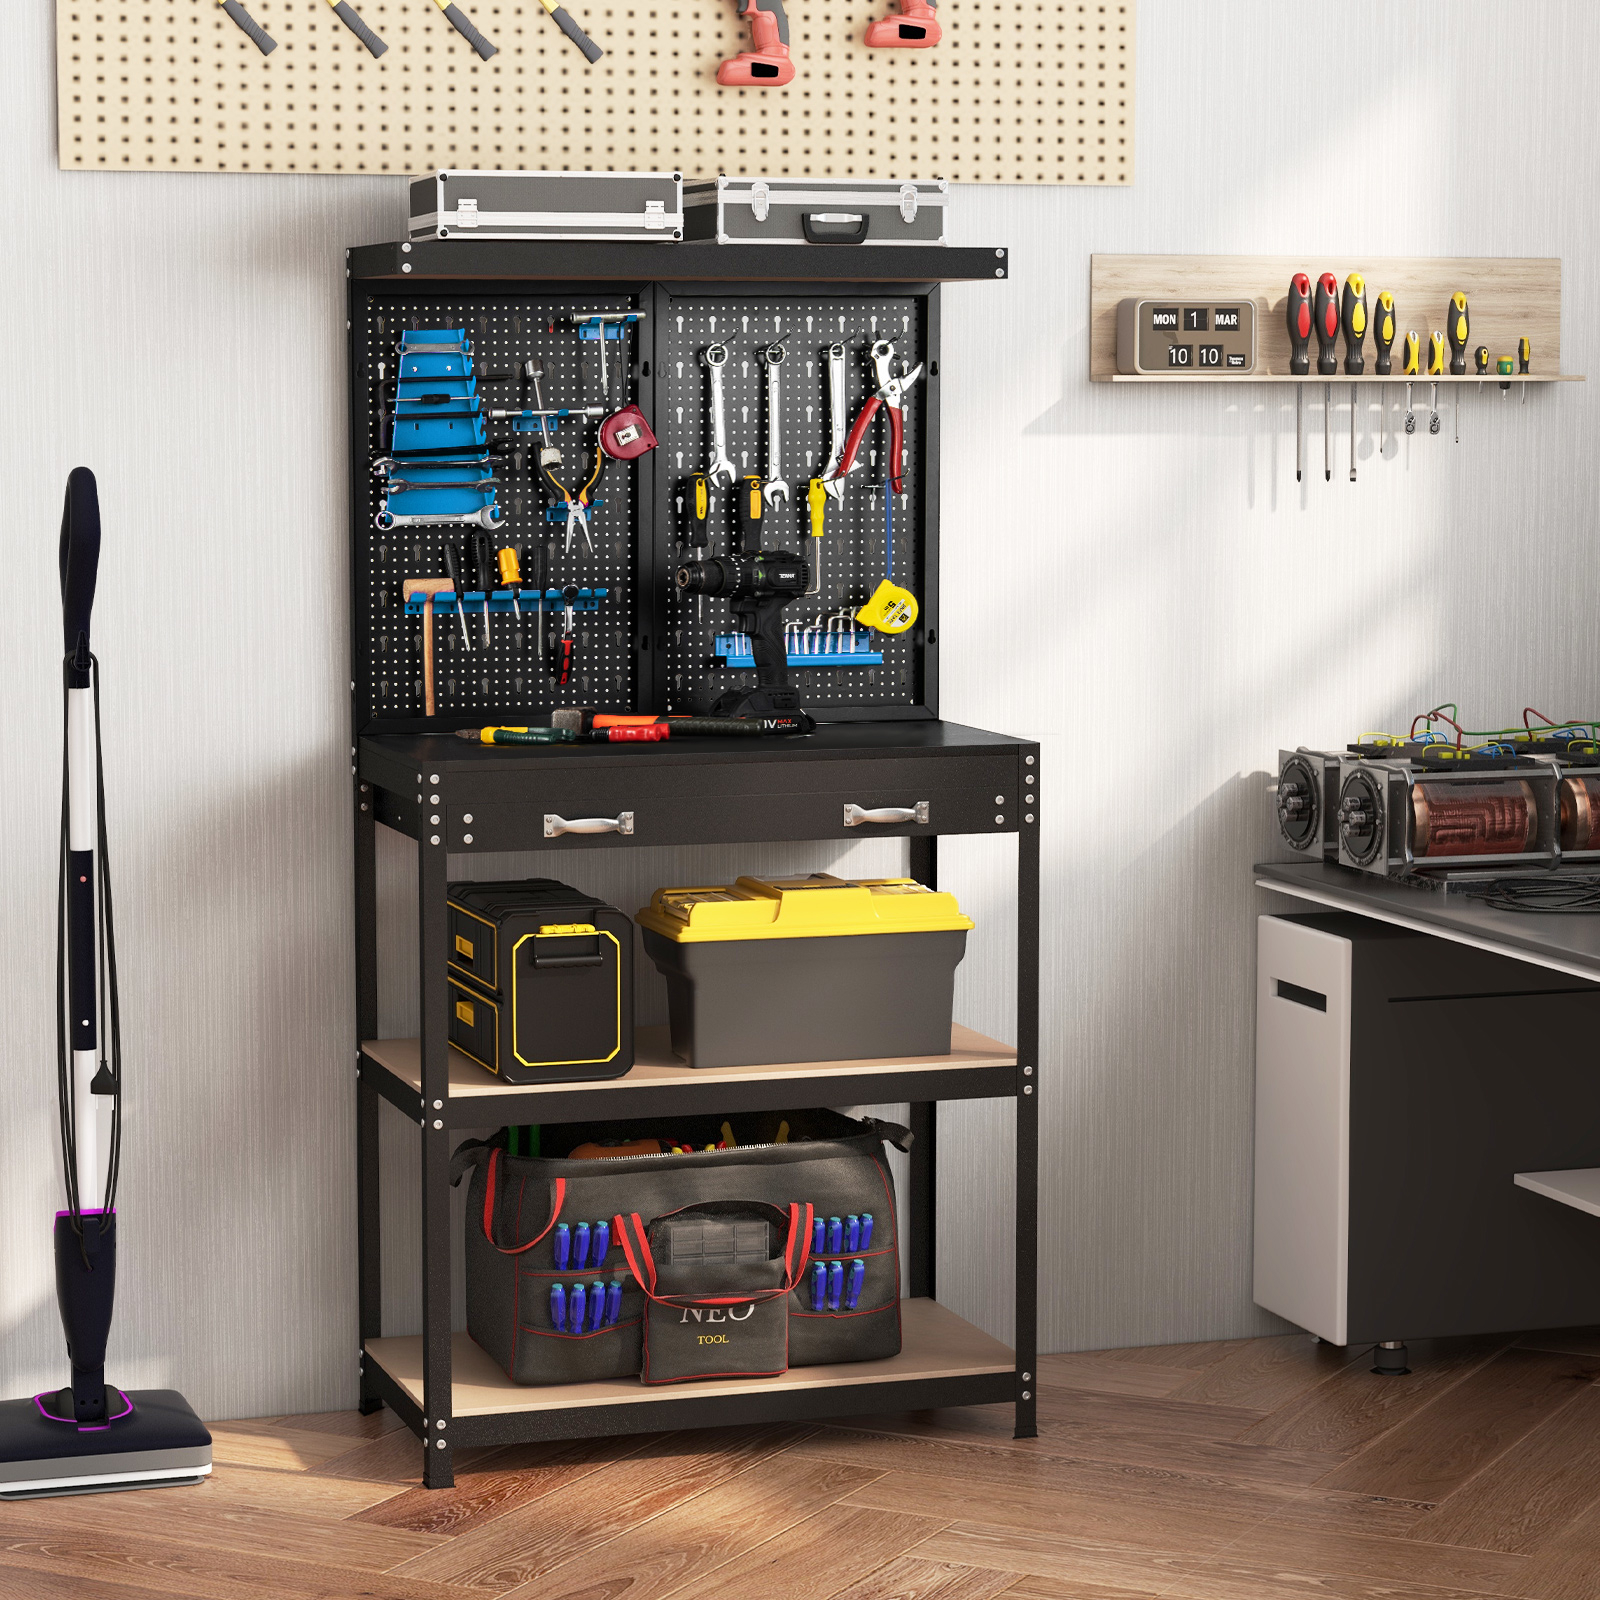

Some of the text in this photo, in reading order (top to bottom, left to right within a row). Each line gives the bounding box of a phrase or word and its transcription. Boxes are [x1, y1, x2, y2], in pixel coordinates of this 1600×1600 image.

[1153, 311, 1238, 328] MON 1 MAR
[1169, 348, 1188, 364] 10
[1200, 348, 1219, 364] 10
[680, 1304, 755, 1323] NEO
[697, 1334, 730, 1345] TOOL
